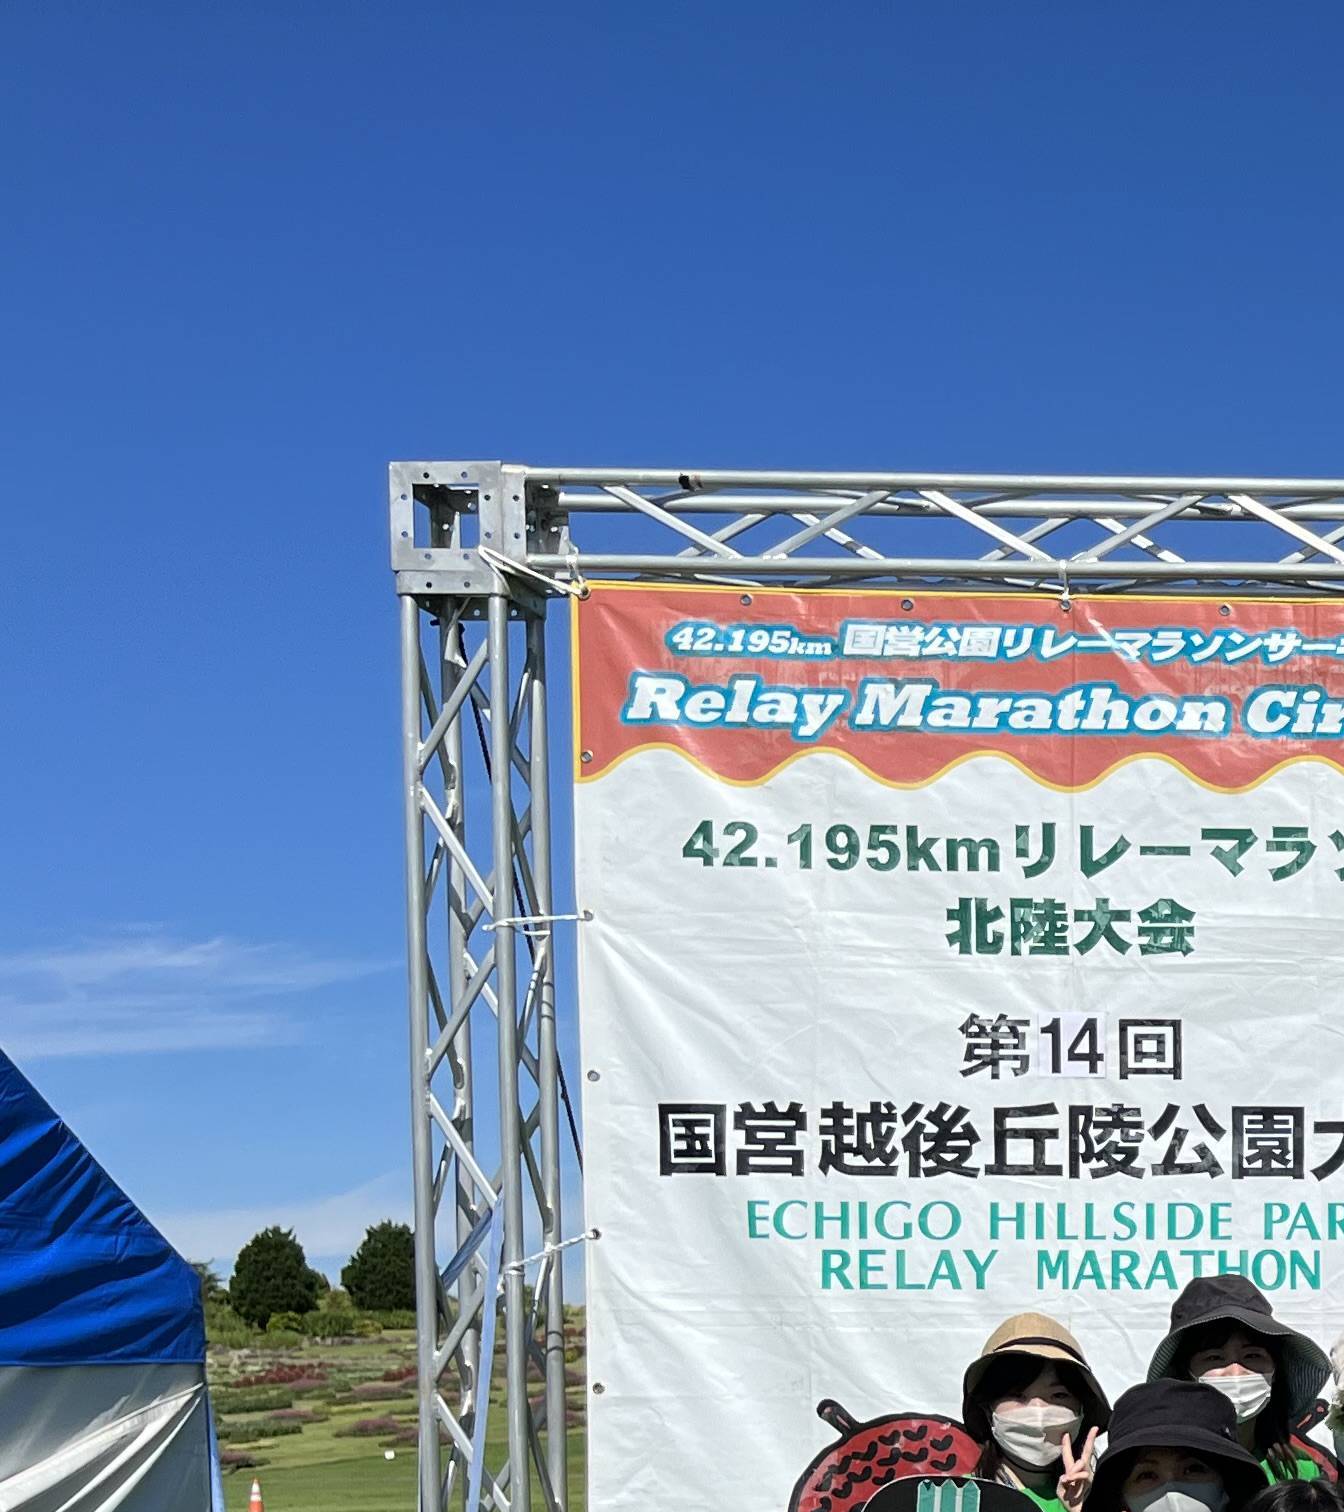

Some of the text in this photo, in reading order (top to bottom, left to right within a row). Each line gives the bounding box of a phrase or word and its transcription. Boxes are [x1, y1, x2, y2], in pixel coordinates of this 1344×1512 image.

[670, 627, 833, 656] 42.195km
[626, 675, 846, 737] Relay
[855, 681, 1227, 733] Marathon
[945, 897, 1196, 957] 北陸大会
[957, 1013, 1183, 1081] 第14回
[747, 1200, 962, 1240] ECHIGO
[990, 1201, 1232, 1241] HILLSIDE
[821, 1249, 1322, 1291] RELAY MARATHON
